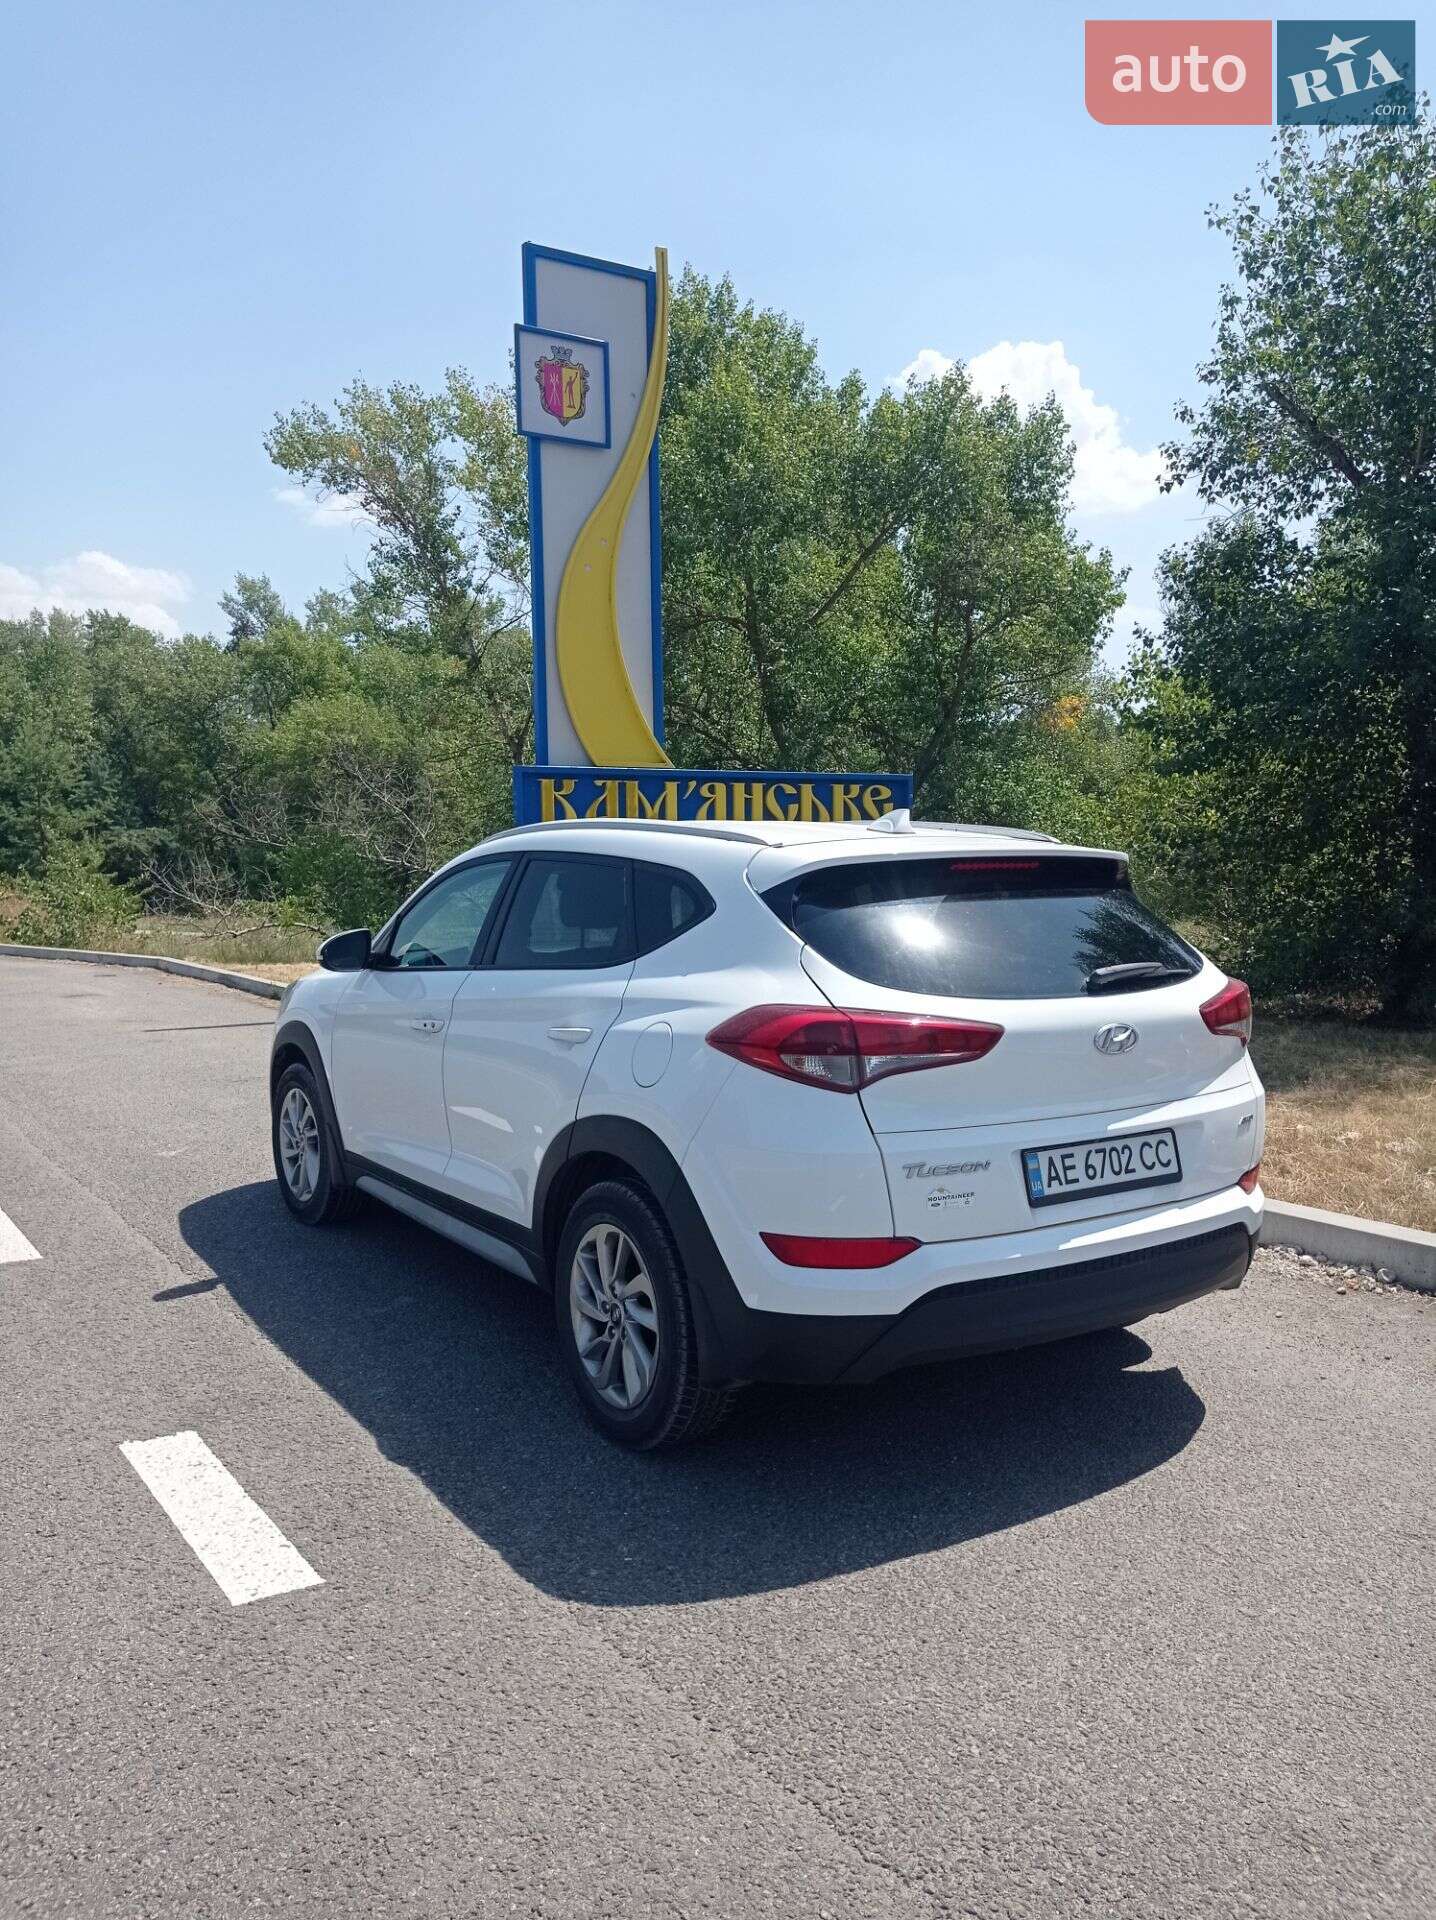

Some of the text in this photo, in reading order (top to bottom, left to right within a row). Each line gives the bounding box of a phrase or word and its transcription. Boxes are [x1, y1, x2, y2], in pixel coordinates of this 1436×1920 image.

[902, 1159, 991, 1179] TUCSON
[1047, 1139, 1172, 1188] AE 6702 CC
[1031, 1180, 1043, 1192] UA
